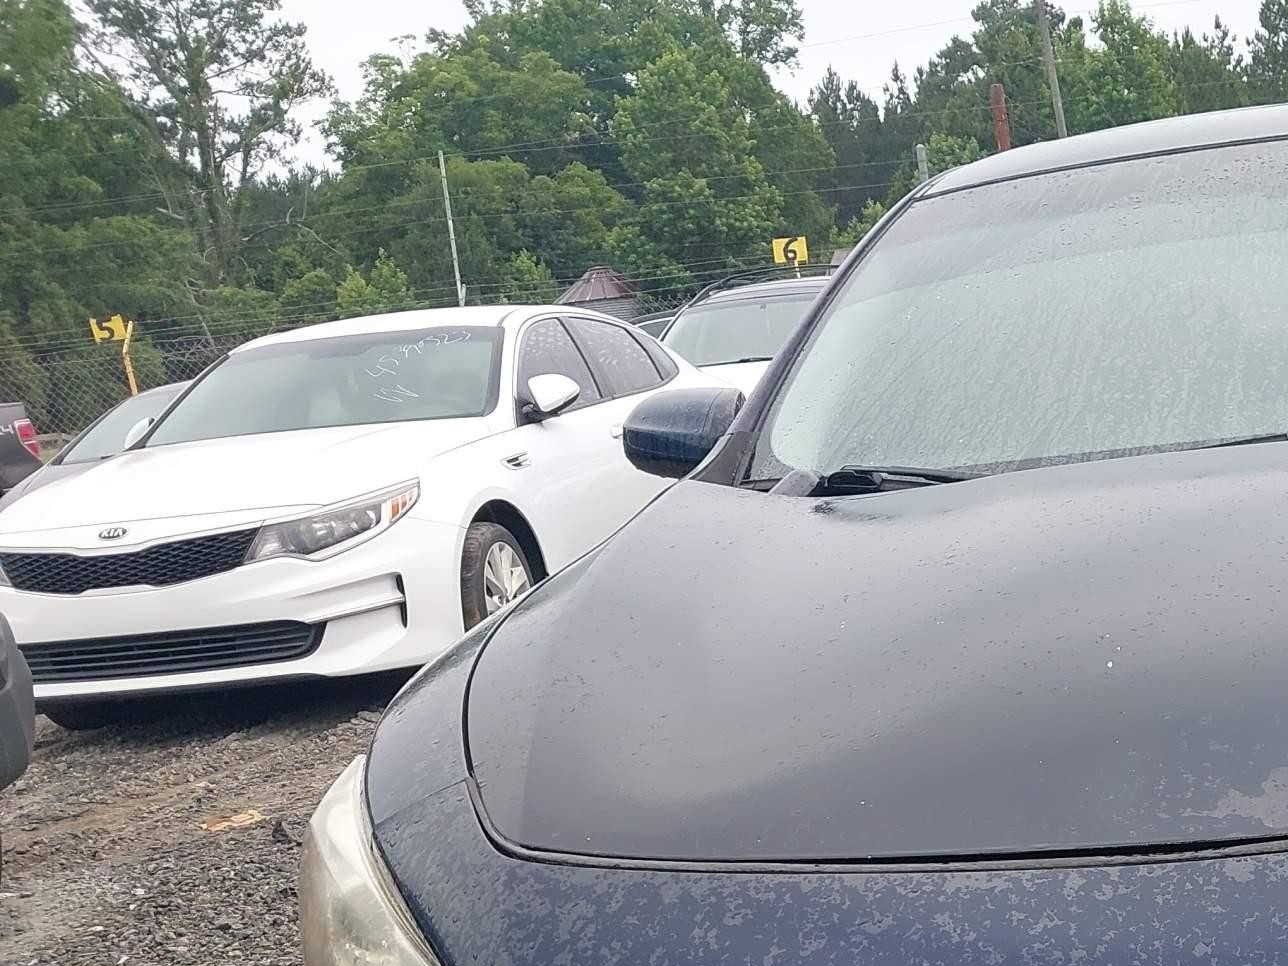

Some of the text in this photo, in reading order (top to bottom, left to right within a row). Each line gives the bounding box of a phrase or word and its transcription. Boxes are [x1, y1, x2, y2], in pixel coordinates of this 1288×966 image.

[783, 237, 797, 263] 6
[95, 317, 115, 342] 5
[100, 528, 124, 538] KIA
